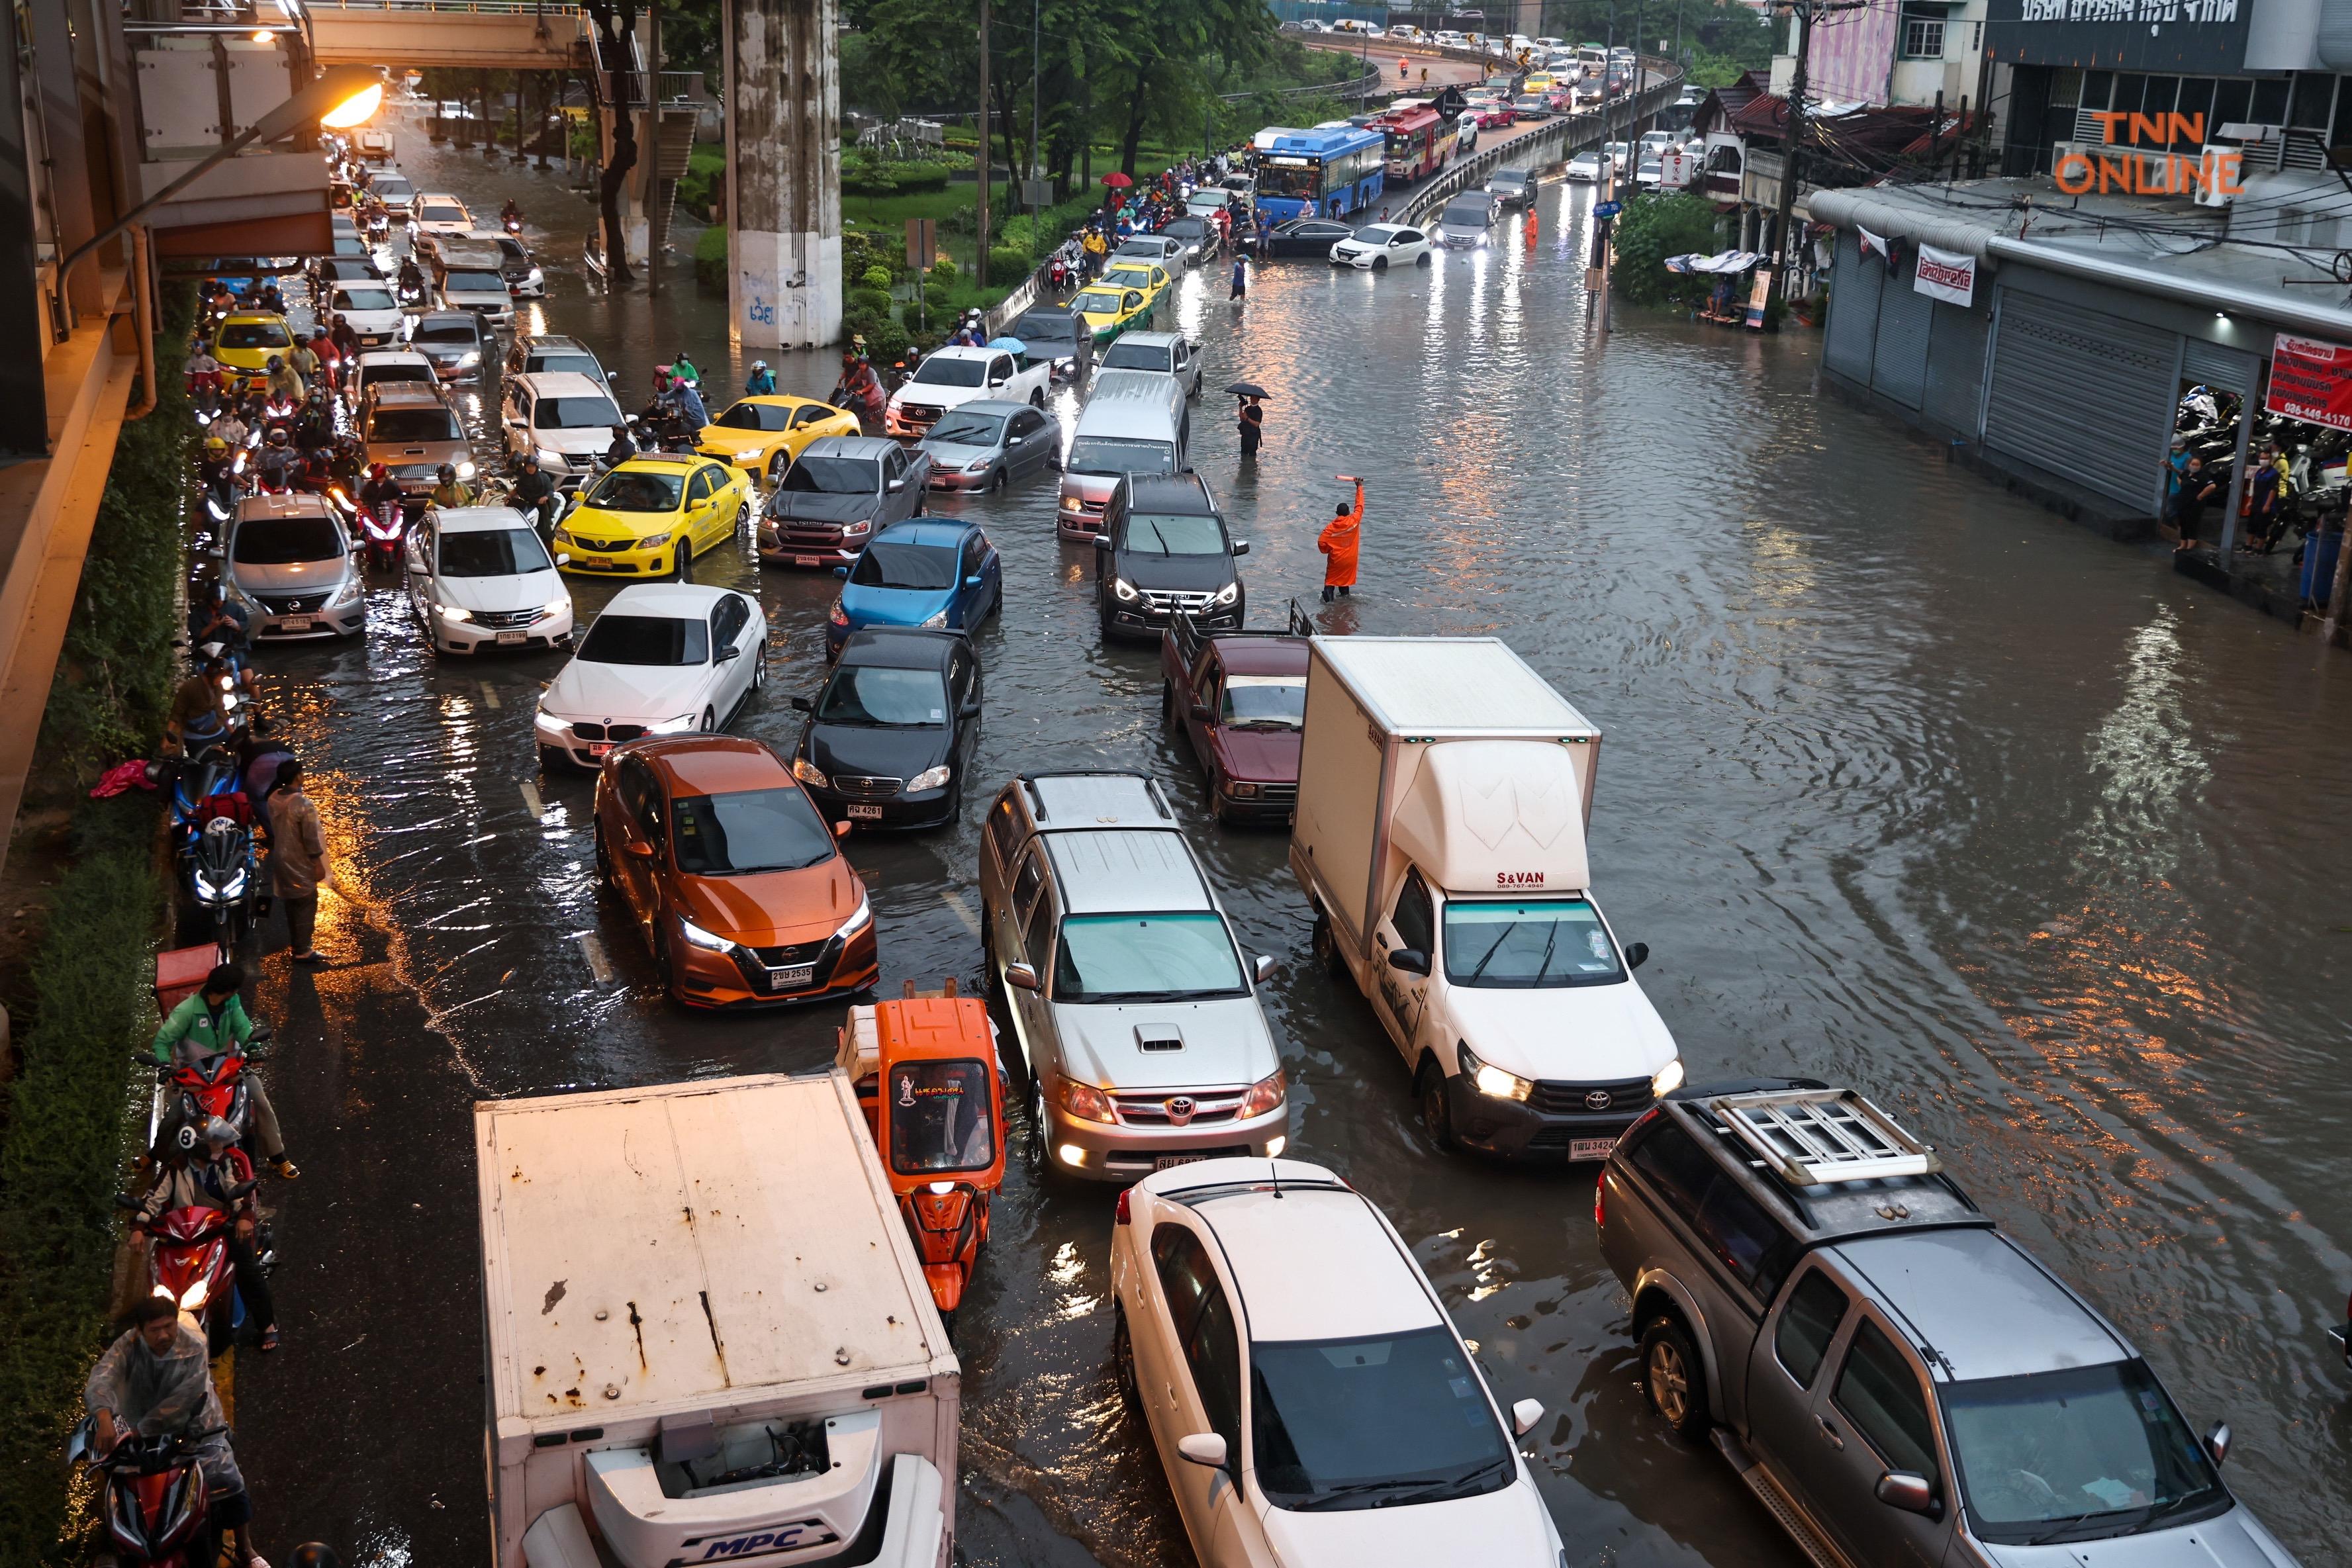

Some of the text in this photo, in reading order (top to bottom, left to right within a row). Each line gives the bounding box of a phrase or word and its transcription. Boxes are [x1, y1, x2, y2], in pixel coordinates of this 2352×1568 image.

[1917, 256, 1971, 291] Lambretta
[863, 806, 880, 815] 4261
[1497, 872, 1544, 884] S&VAN
[791, 968, 811, 978] 2535
[181, 1129, 192, 1146] 8
[1592, 1141, 1613, 1150] 3424
[703, 1528, 804, 1559] MPC
